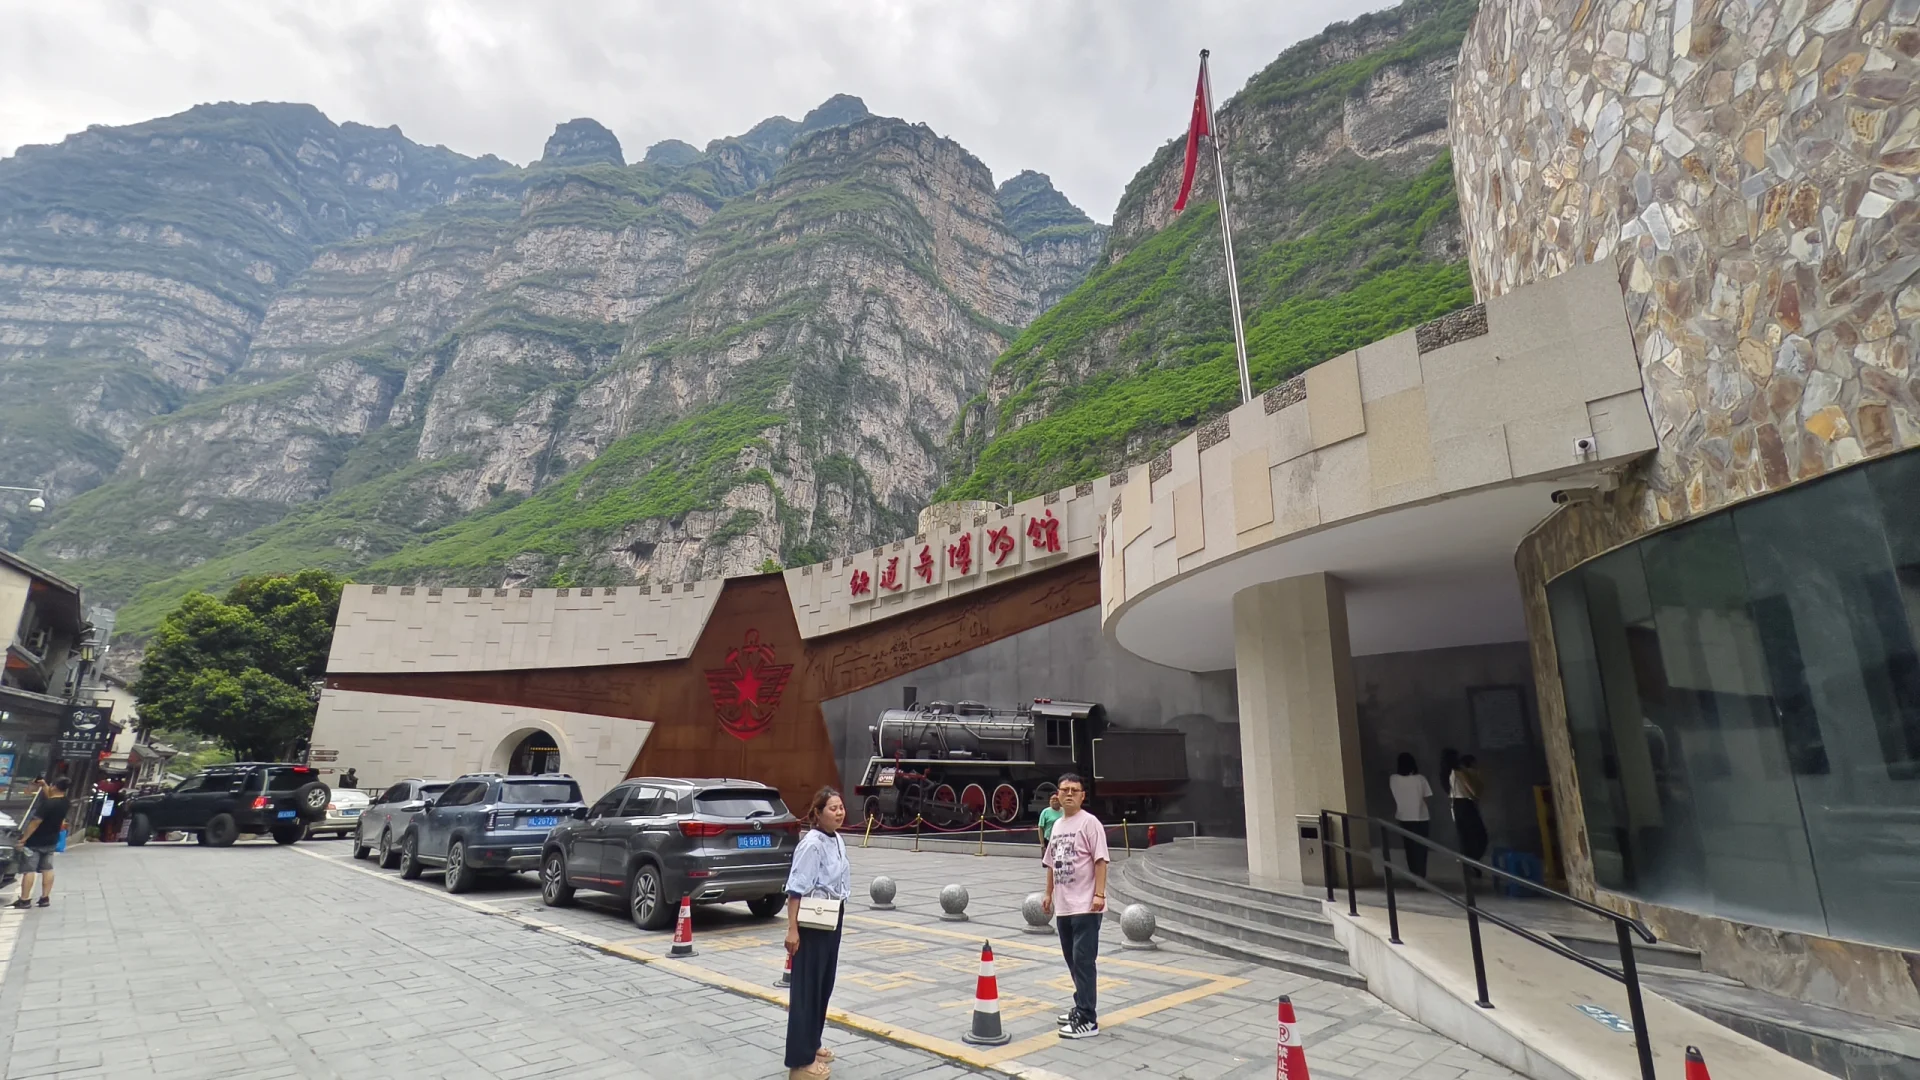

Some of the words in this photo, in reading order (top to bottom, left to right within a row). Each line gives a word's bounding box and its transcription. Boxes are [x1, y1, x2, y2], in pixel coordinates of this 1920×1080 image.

[850, 508, 1061, 597] 铁道兵博物馆
